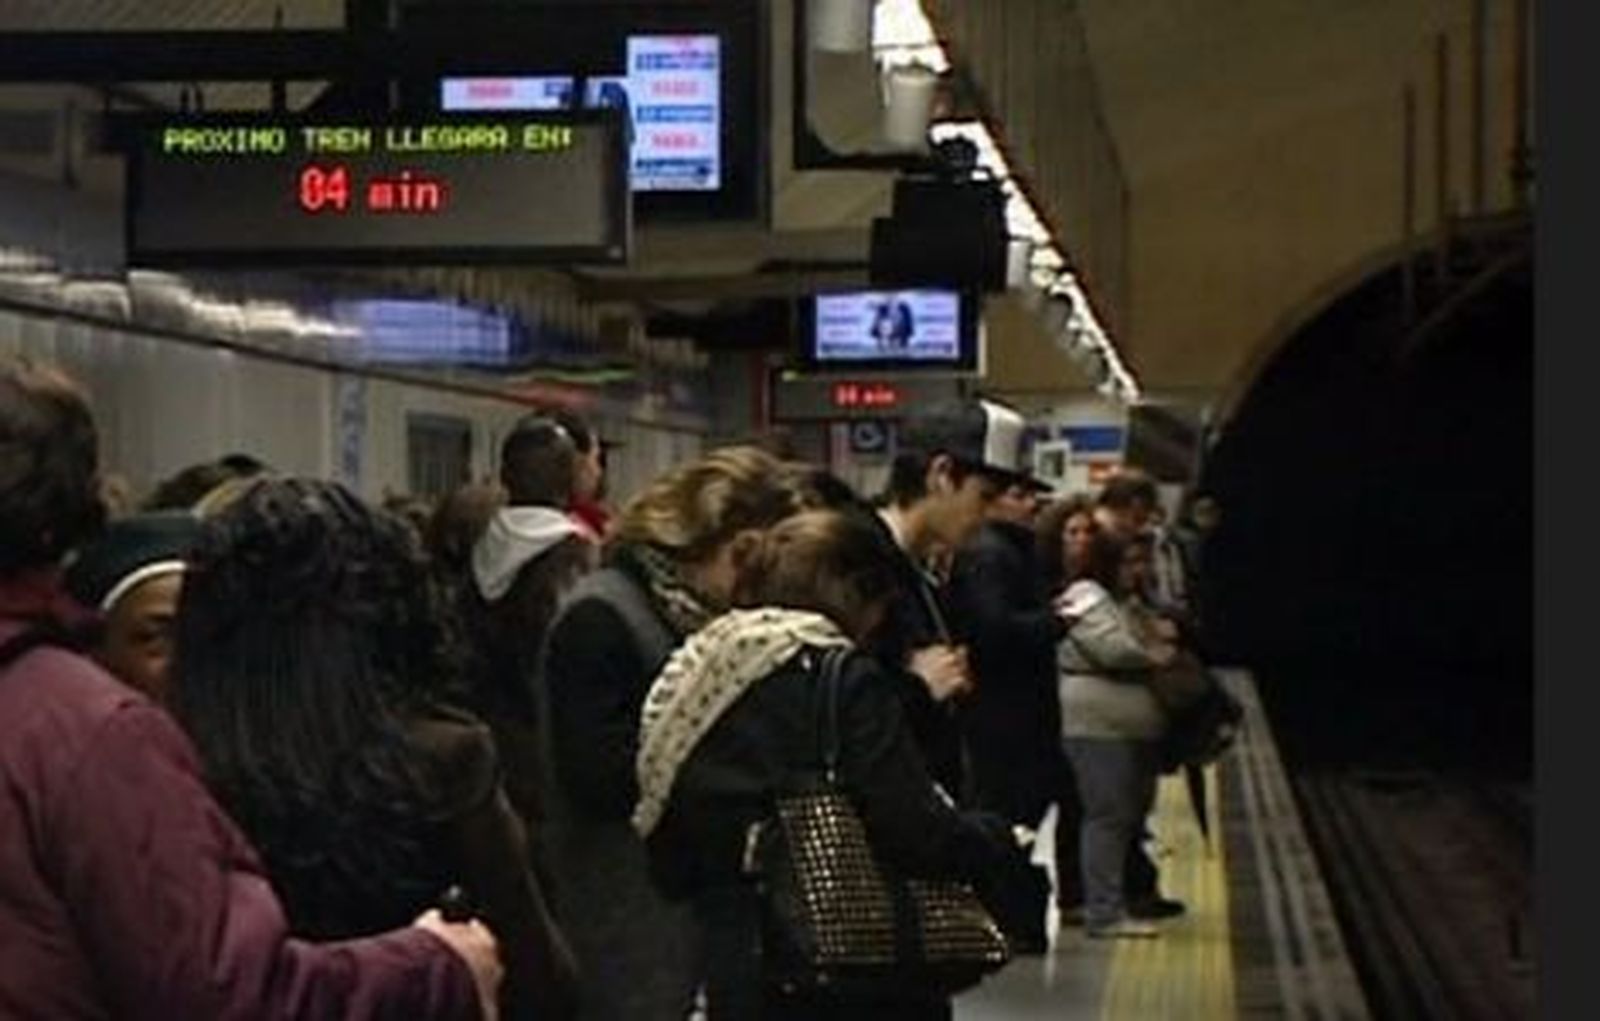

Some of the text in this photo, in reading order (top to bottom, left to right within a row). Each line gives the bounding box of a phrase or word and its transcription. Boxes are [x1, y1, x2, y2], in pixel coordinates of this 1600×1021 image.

[163, 127, 286, 153] PROXIMO
[302, 126, 371, 151] TREN
[386, 125, 508, 149] LLEGARA
[301, 167, 438, 210] 04 min
